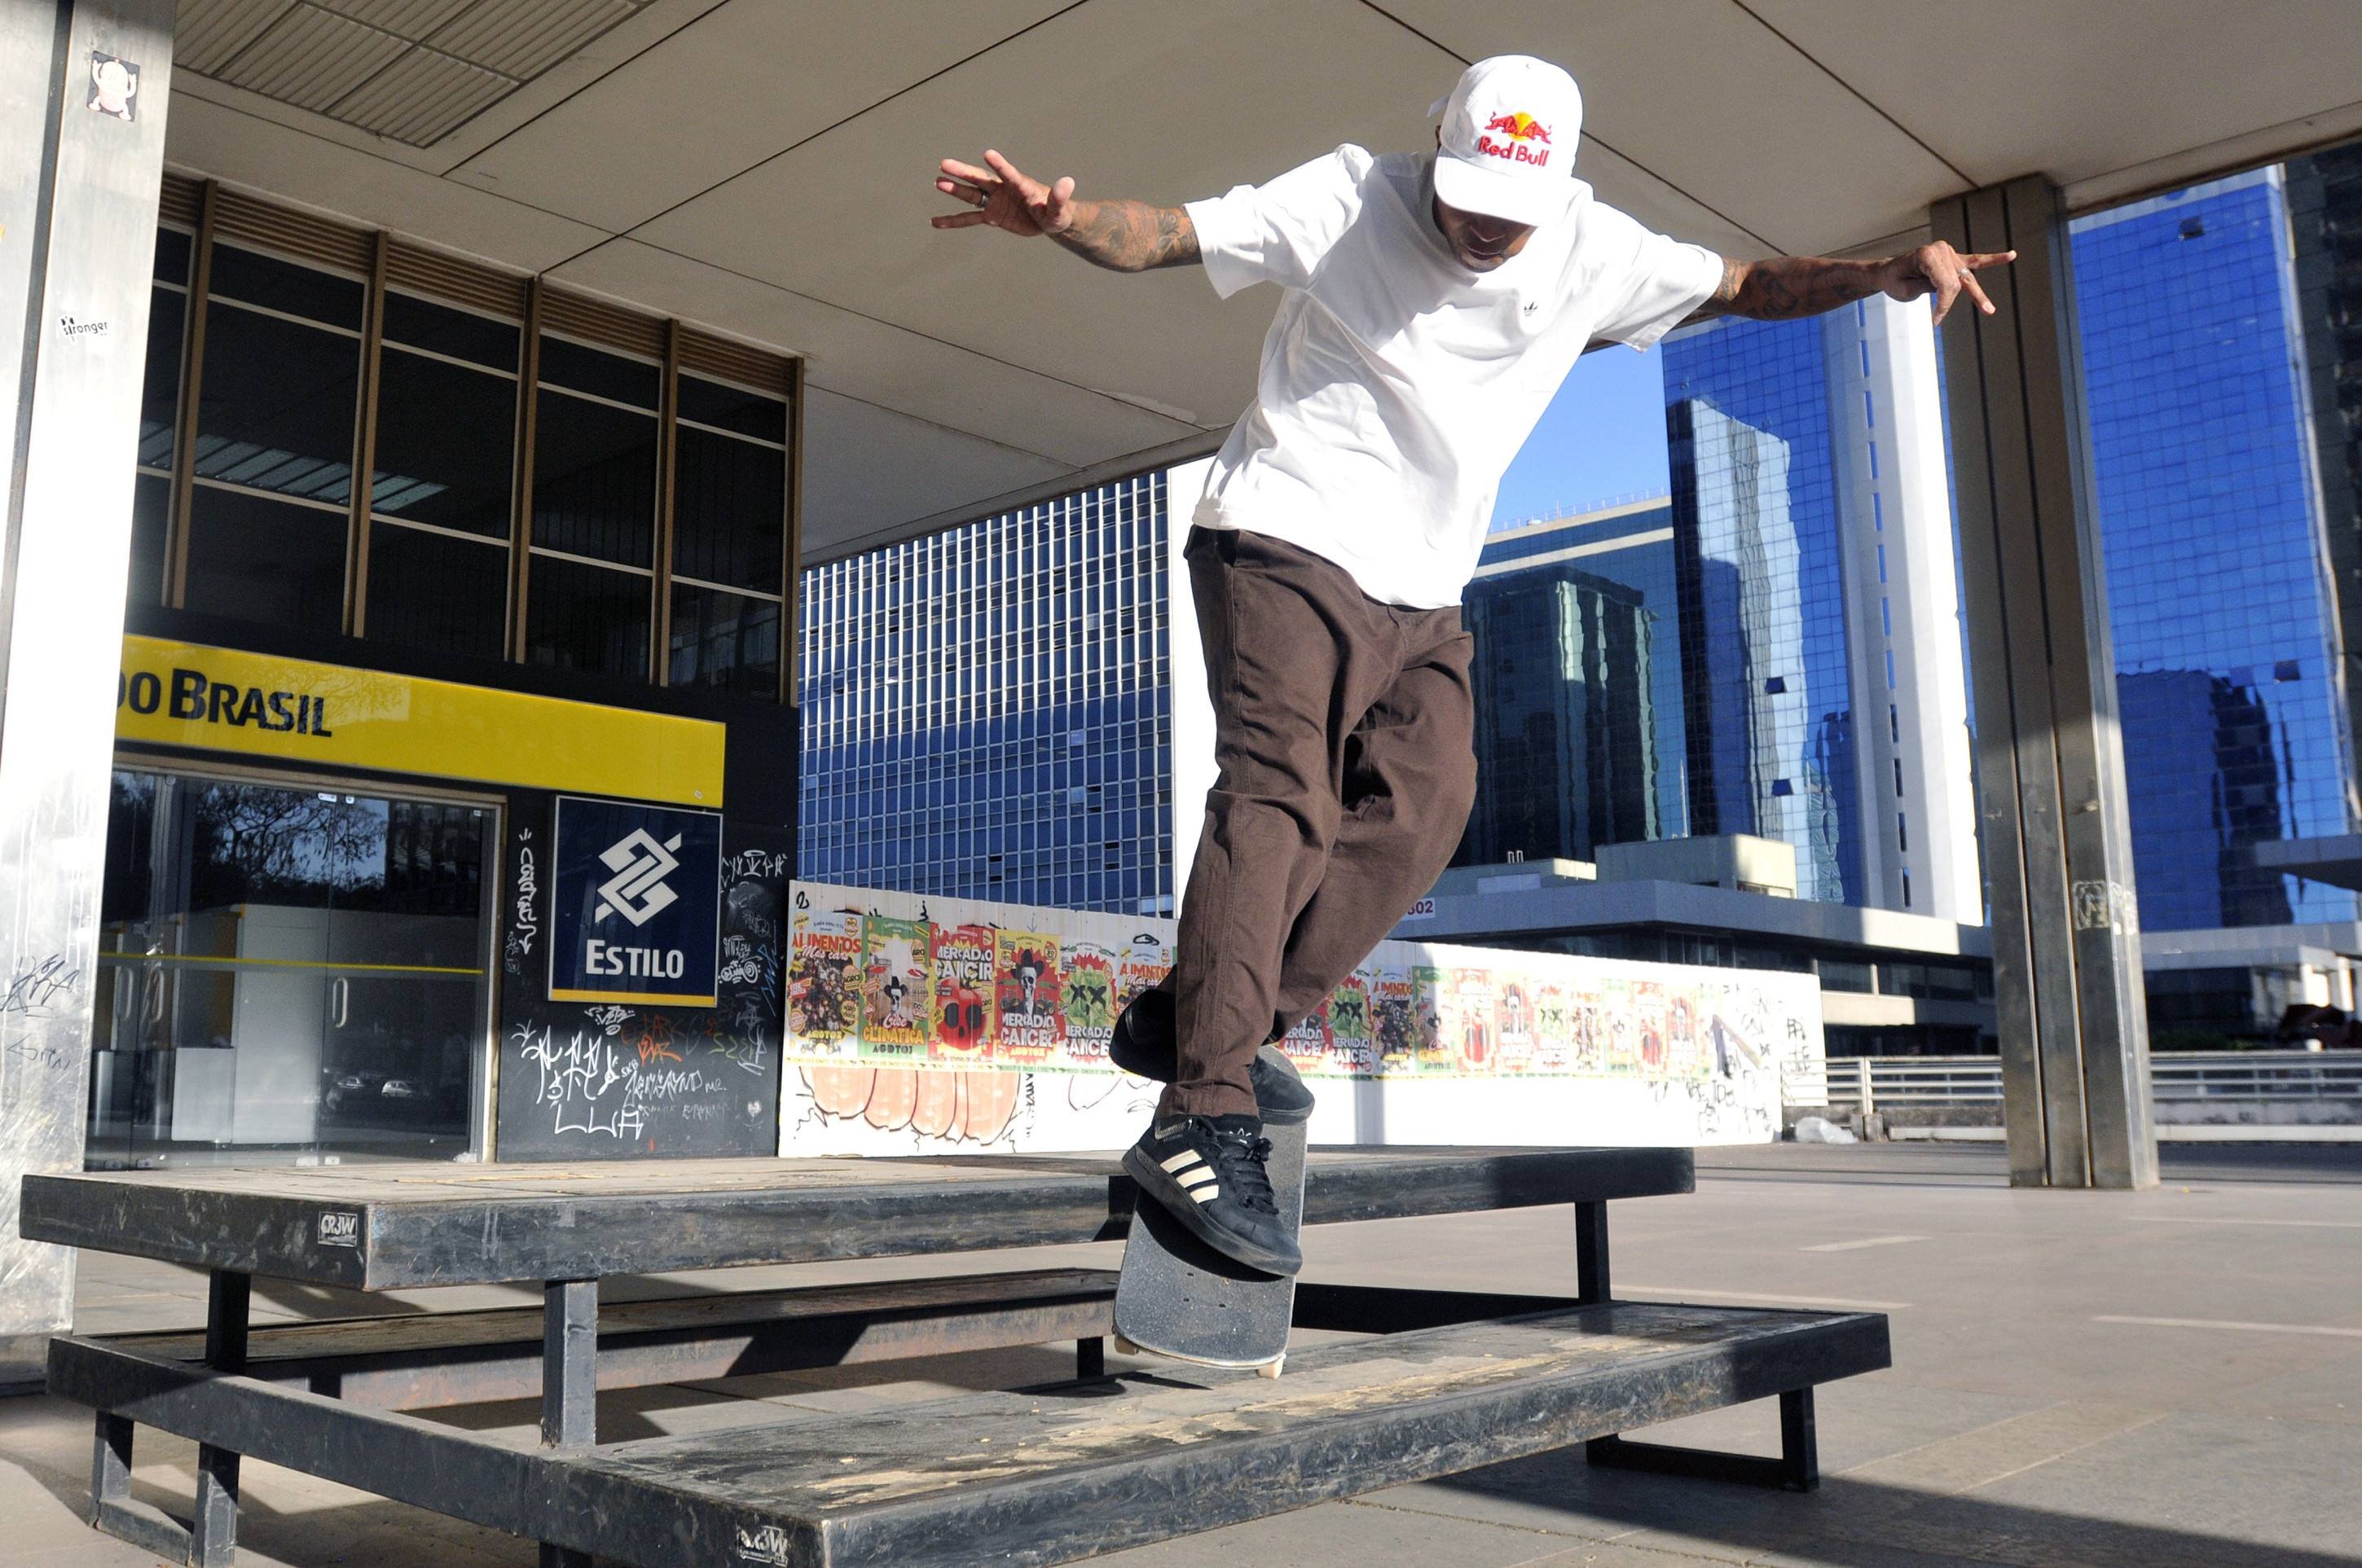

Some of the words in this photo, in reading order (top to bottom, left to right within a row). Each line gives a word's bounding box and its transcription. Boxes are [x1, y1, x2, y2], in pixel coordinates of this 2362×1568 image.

[1478, 135, 1515, 160] Red
[1515, 145, 1550, 167] Bull
[117, 671, 161, 714] O
[168, 668, 332, 737] BRASIL
[586, 938, 684, 979] ESTILO
